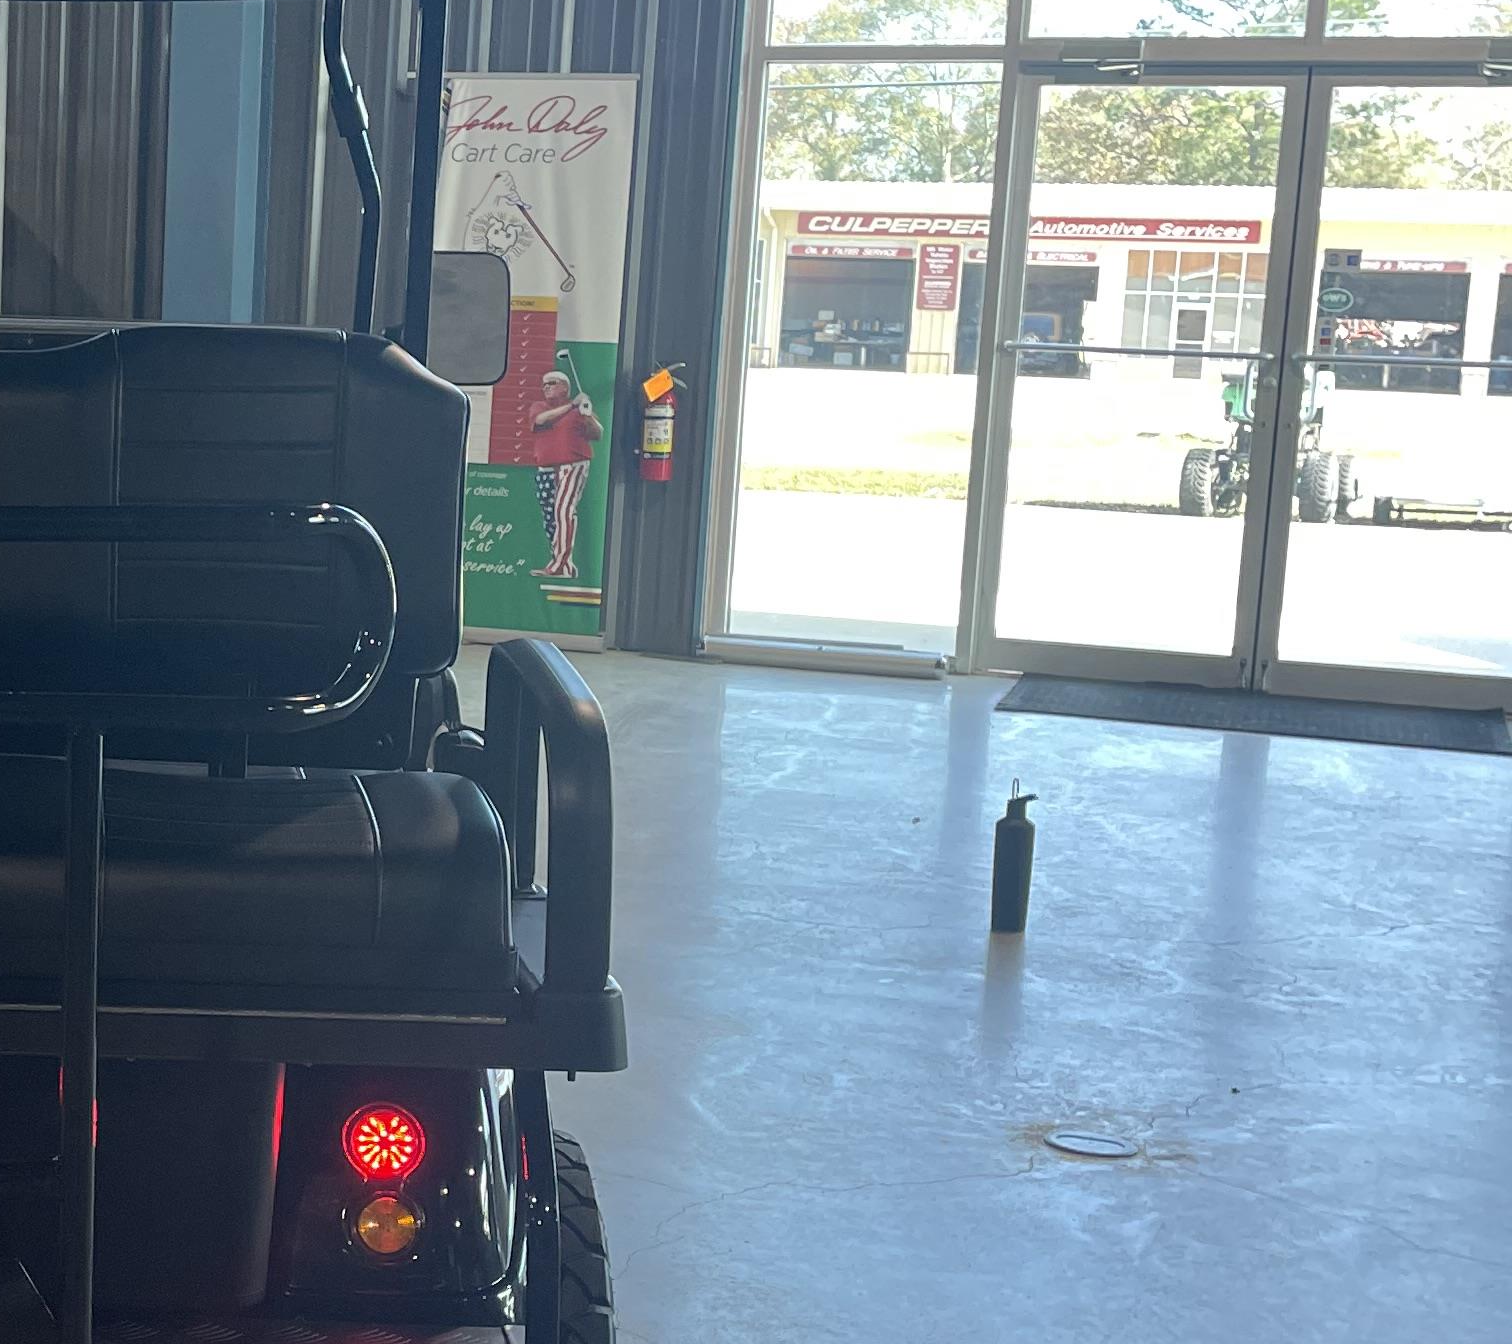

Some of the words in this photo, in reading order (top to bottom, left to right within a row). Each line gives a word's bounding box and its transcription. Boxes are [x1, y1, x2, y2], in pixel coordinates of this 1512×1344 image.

[451, 142, 498, 163] Cart
[504, 142, 556, 164] Care
[1029, 220, 1146, 236] Automotive
[1156, 222, 1250, 239] Services
[473, 485, 510, 497] details
[470, 514, 493, 539] lay
[495, 523, 513, 540] up
[476, 538, 494, 553] at
